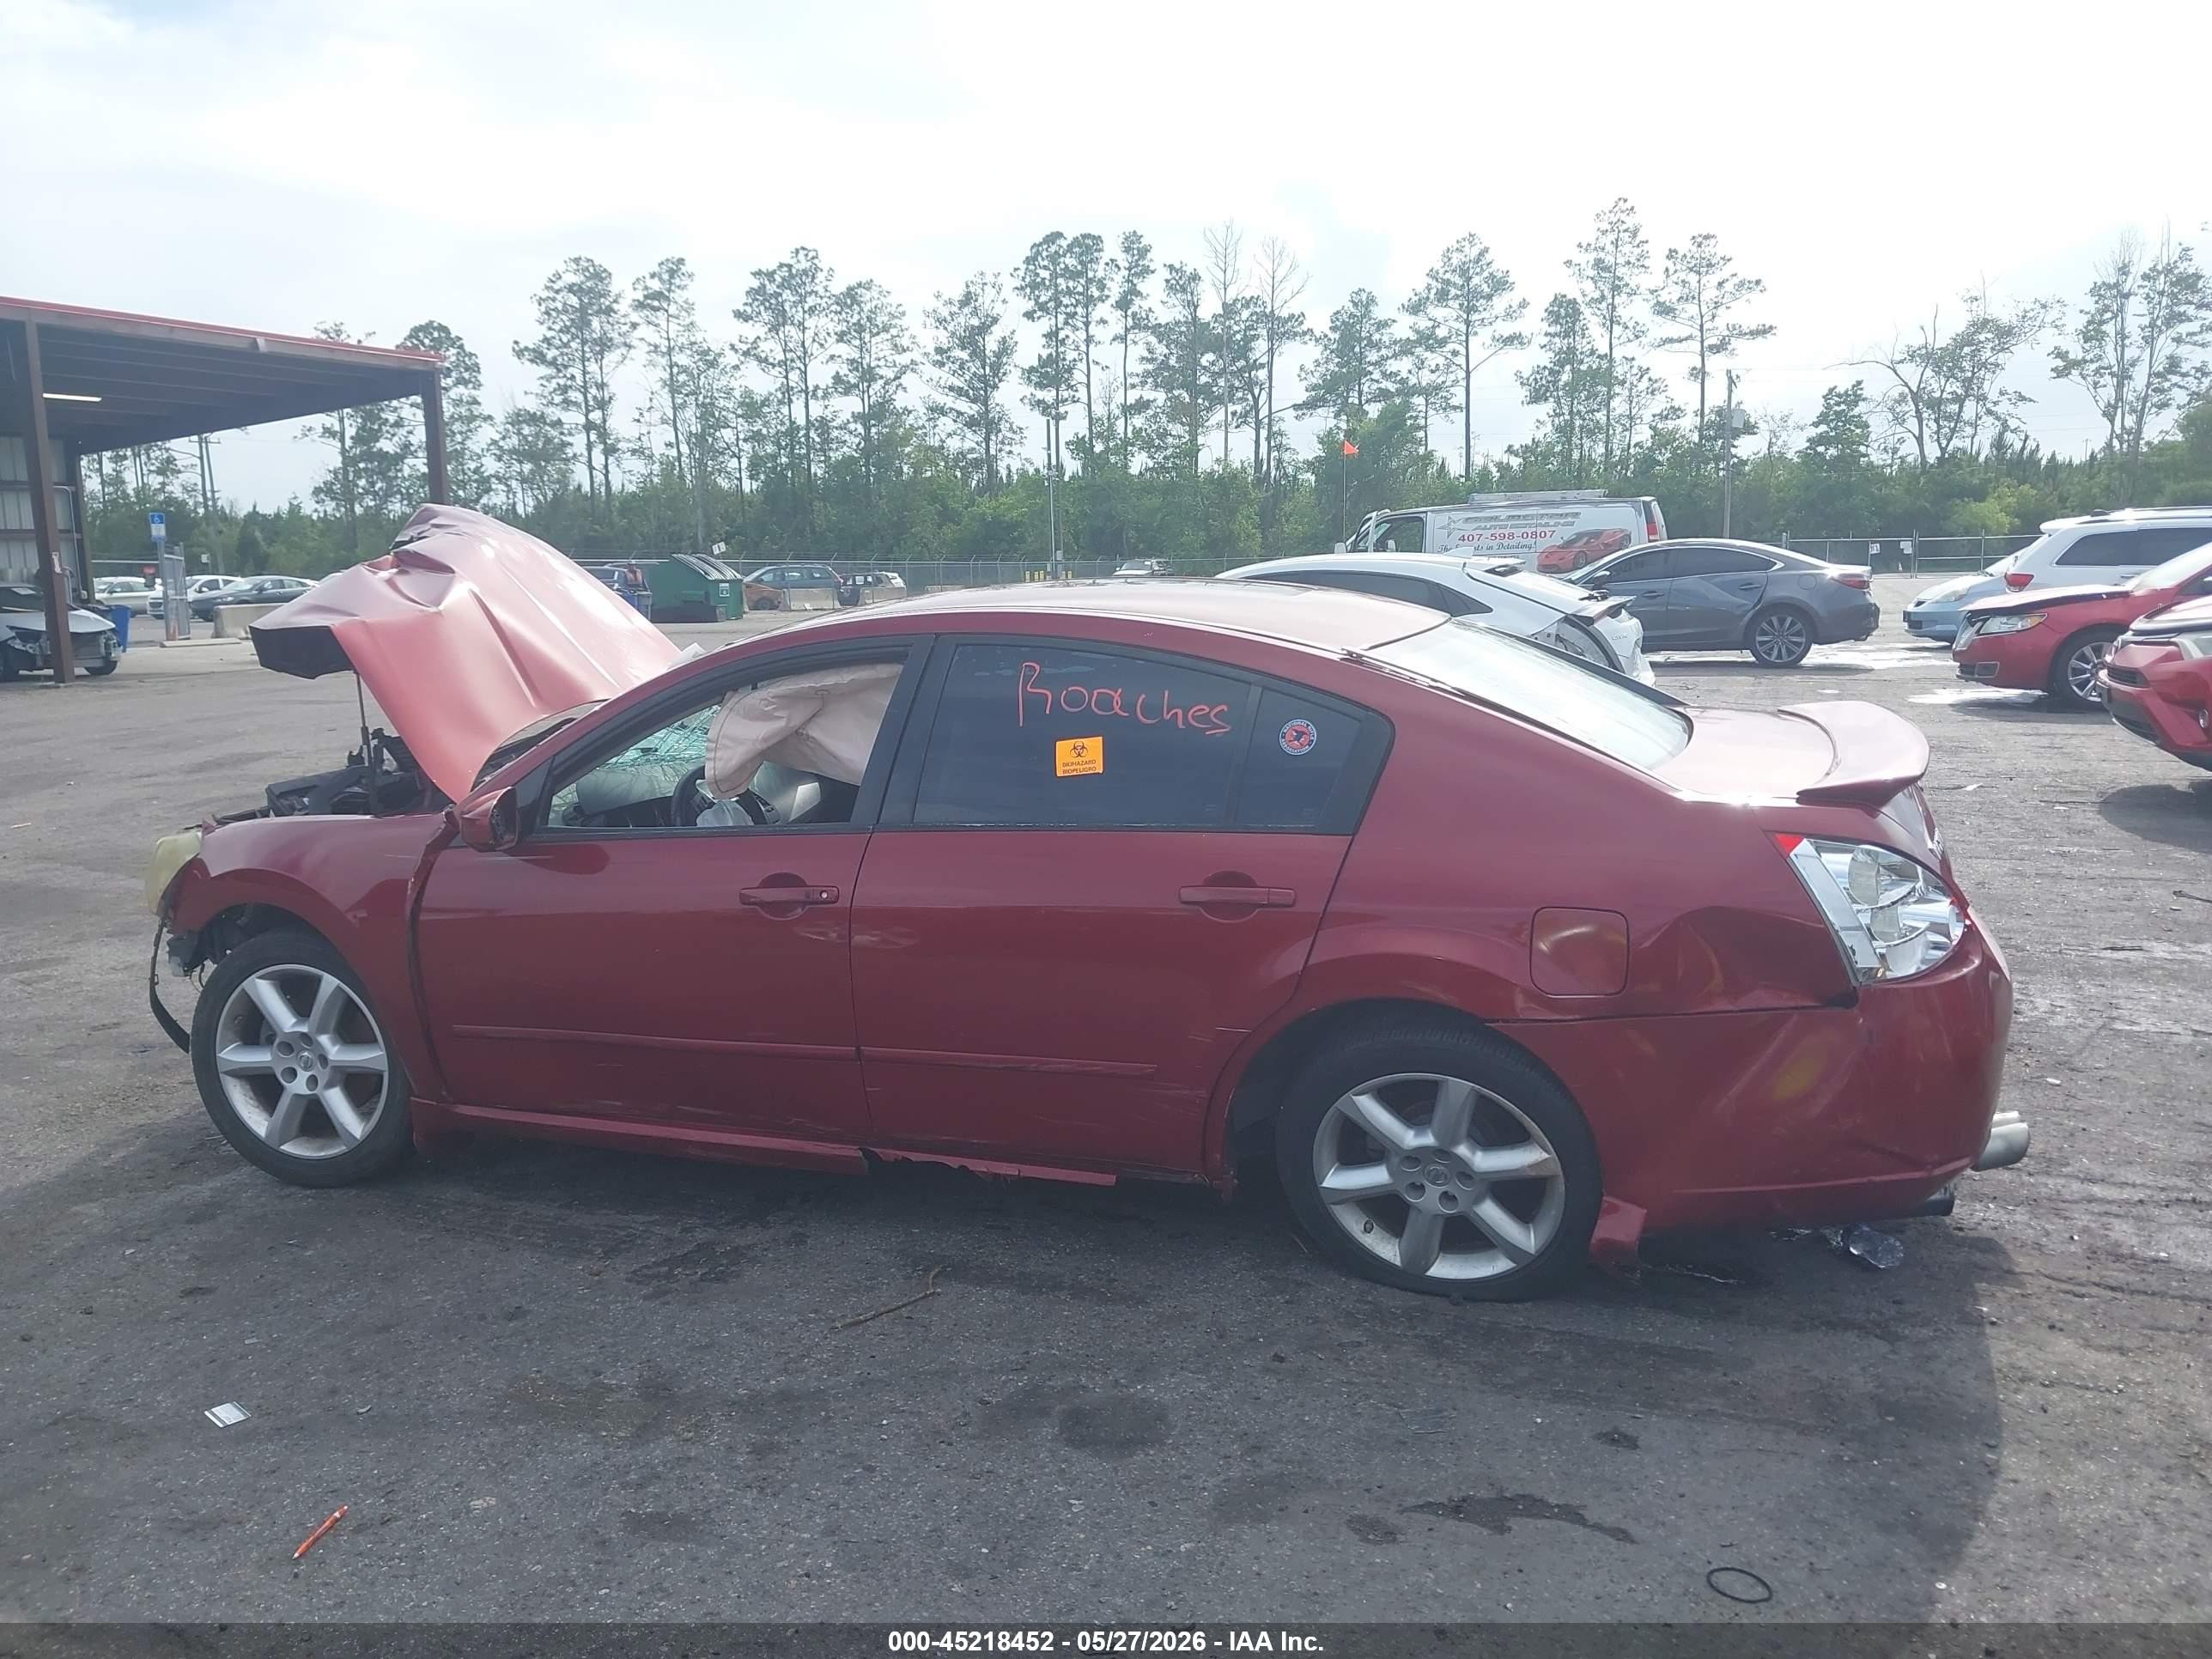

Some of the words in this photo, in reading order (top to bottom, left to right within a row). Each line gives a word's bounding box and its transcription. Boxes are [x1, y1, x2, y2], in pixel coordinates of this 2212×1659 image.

[1458, 530, 1556, 543] 407-598-0807
[1486, 543, 1493, 551] in
[1496, 540, 1537, 551] Detailing!
[1018, 662, 1231, 734] Roaches
[1062, 759, 1097, 768] BIOHAZARD
[1062, 766, 1097, 775] BIOPELIGRO
